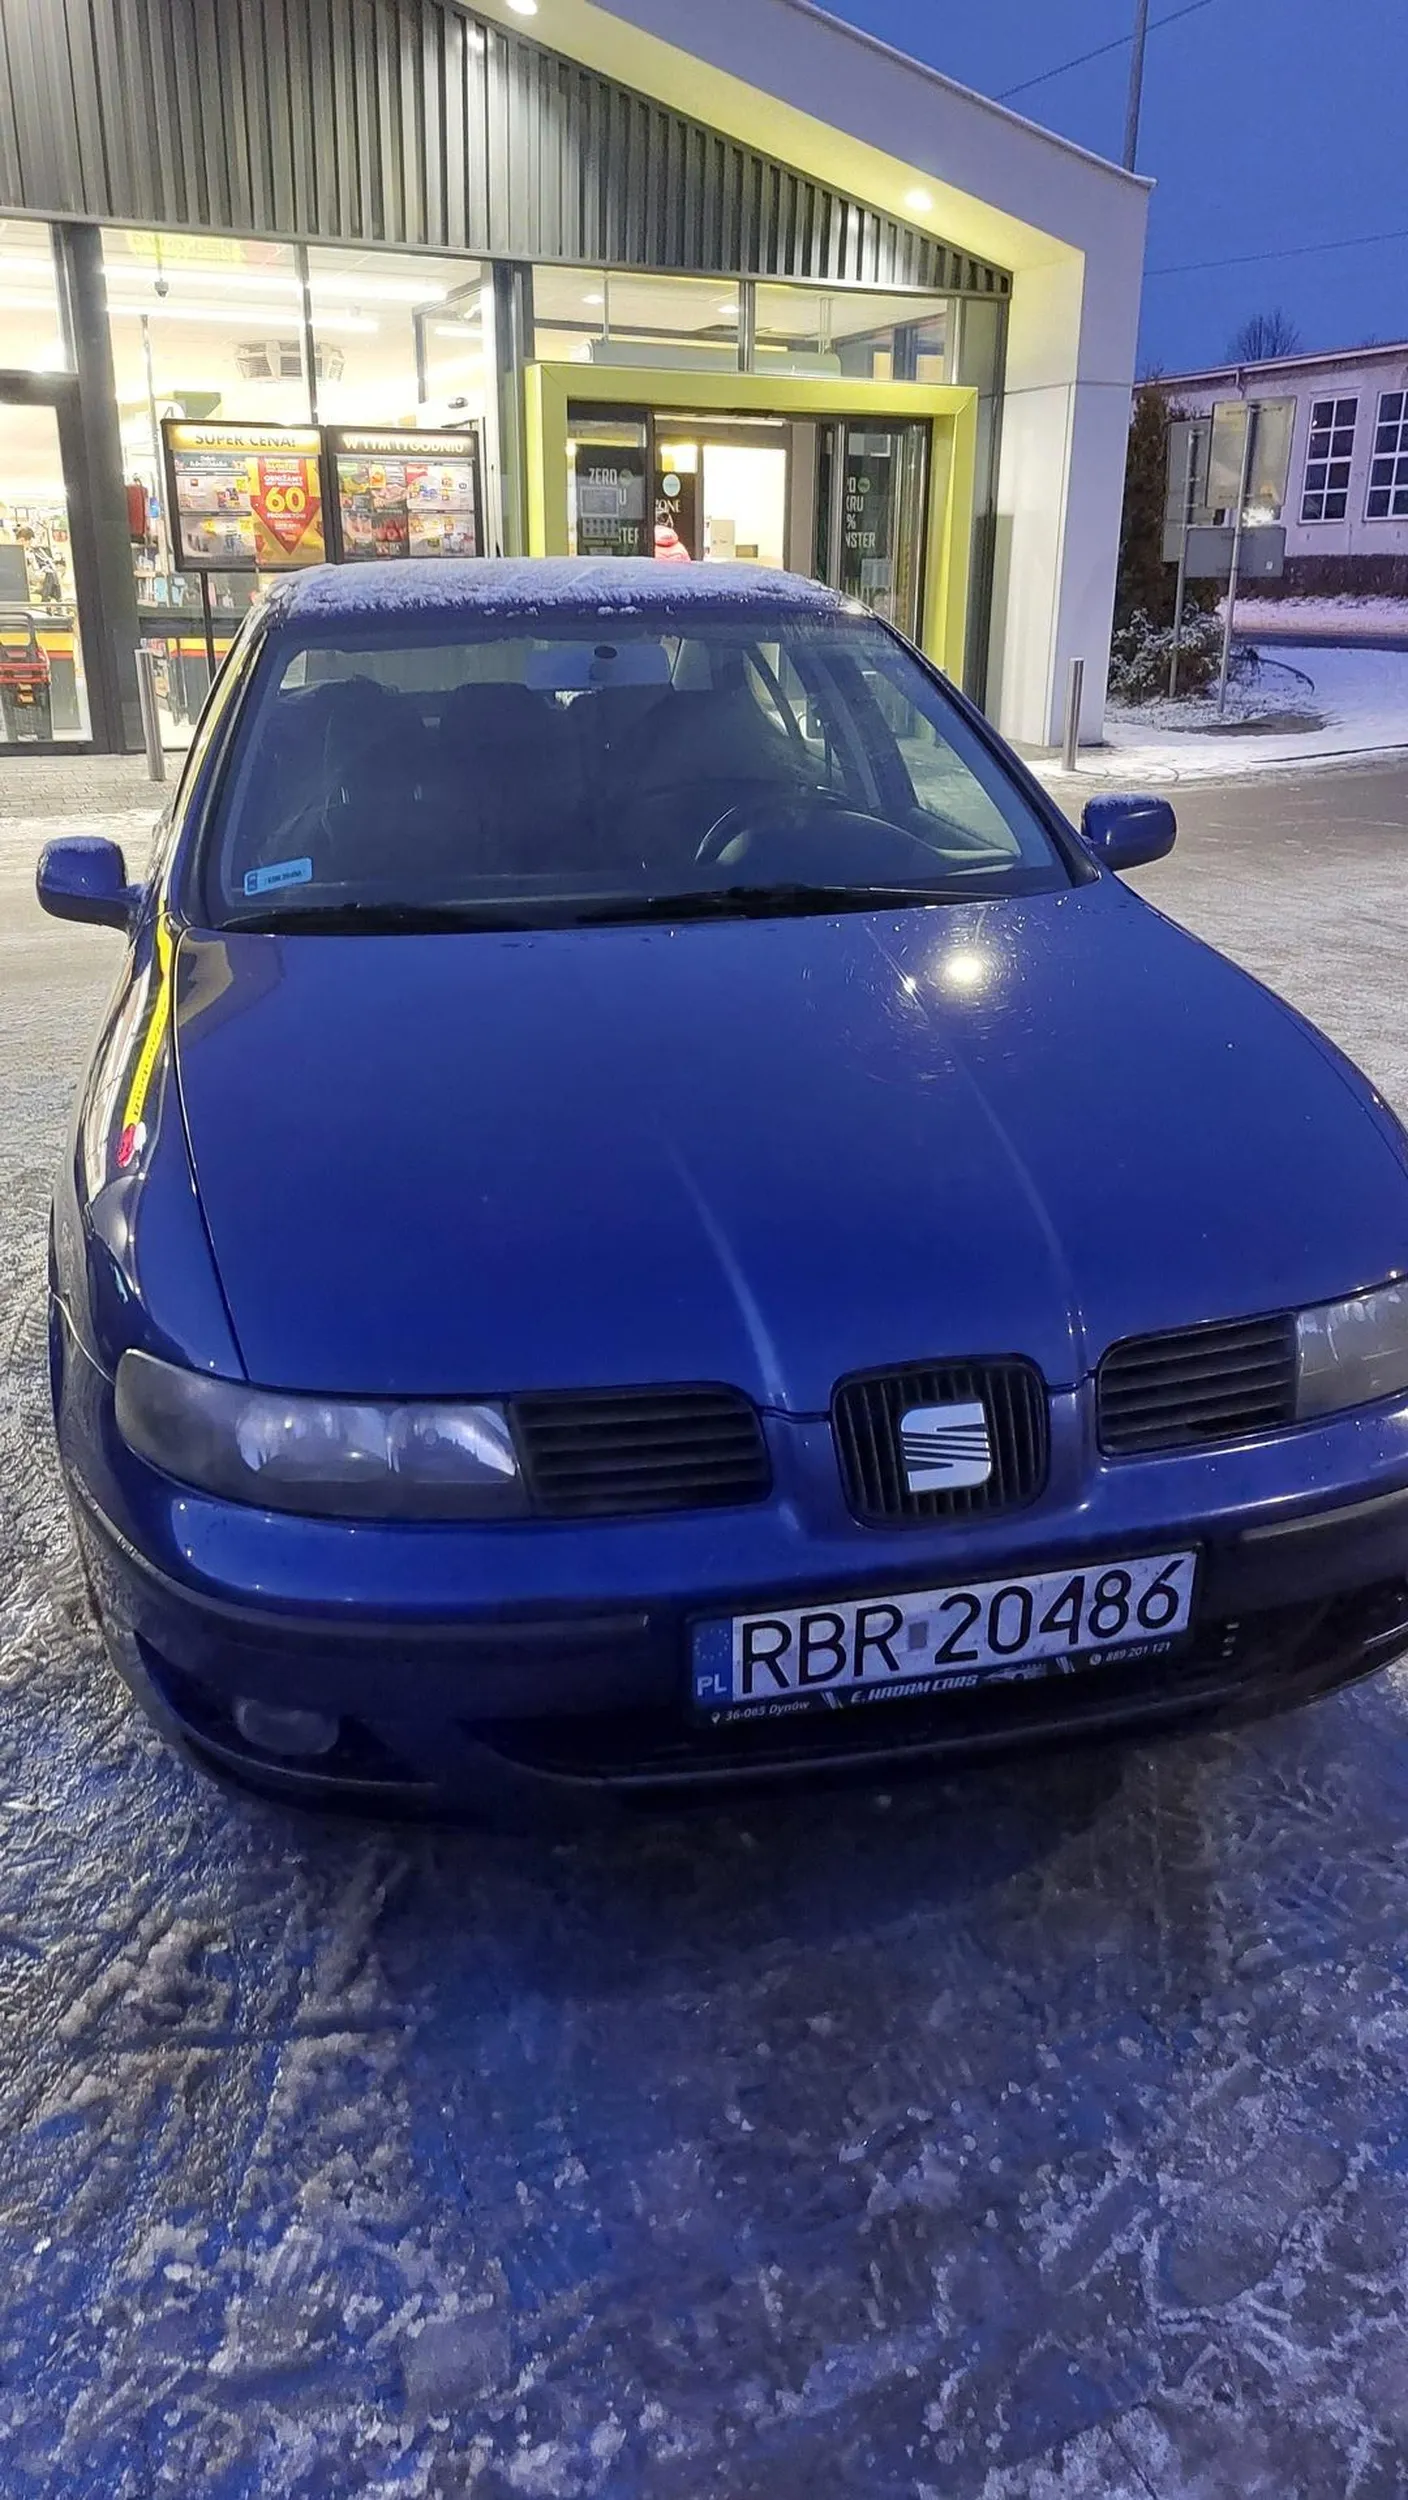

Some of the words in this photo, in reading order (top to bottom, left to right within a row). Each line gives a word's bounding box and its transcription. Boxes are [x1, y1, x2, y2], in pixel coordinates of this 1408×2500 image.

[195, 433, 244, 446] SUPER
[249, 434, 297, 448] CENA!
[343, 436, 359, 450] W
[394, 438, 464, 453] TYGODNIU
[588, 467, 618, 485] ZERO
[265, 486, 306, 513] 60
[741, 1603, 903, 1694] RBR
[934, 1559, 1184, 1665] 20486
[696, 1674, 727, 1696] PL
[931, 1675, 979, 1692] CARS
[769, 1700, 811, 1717] Dynów
